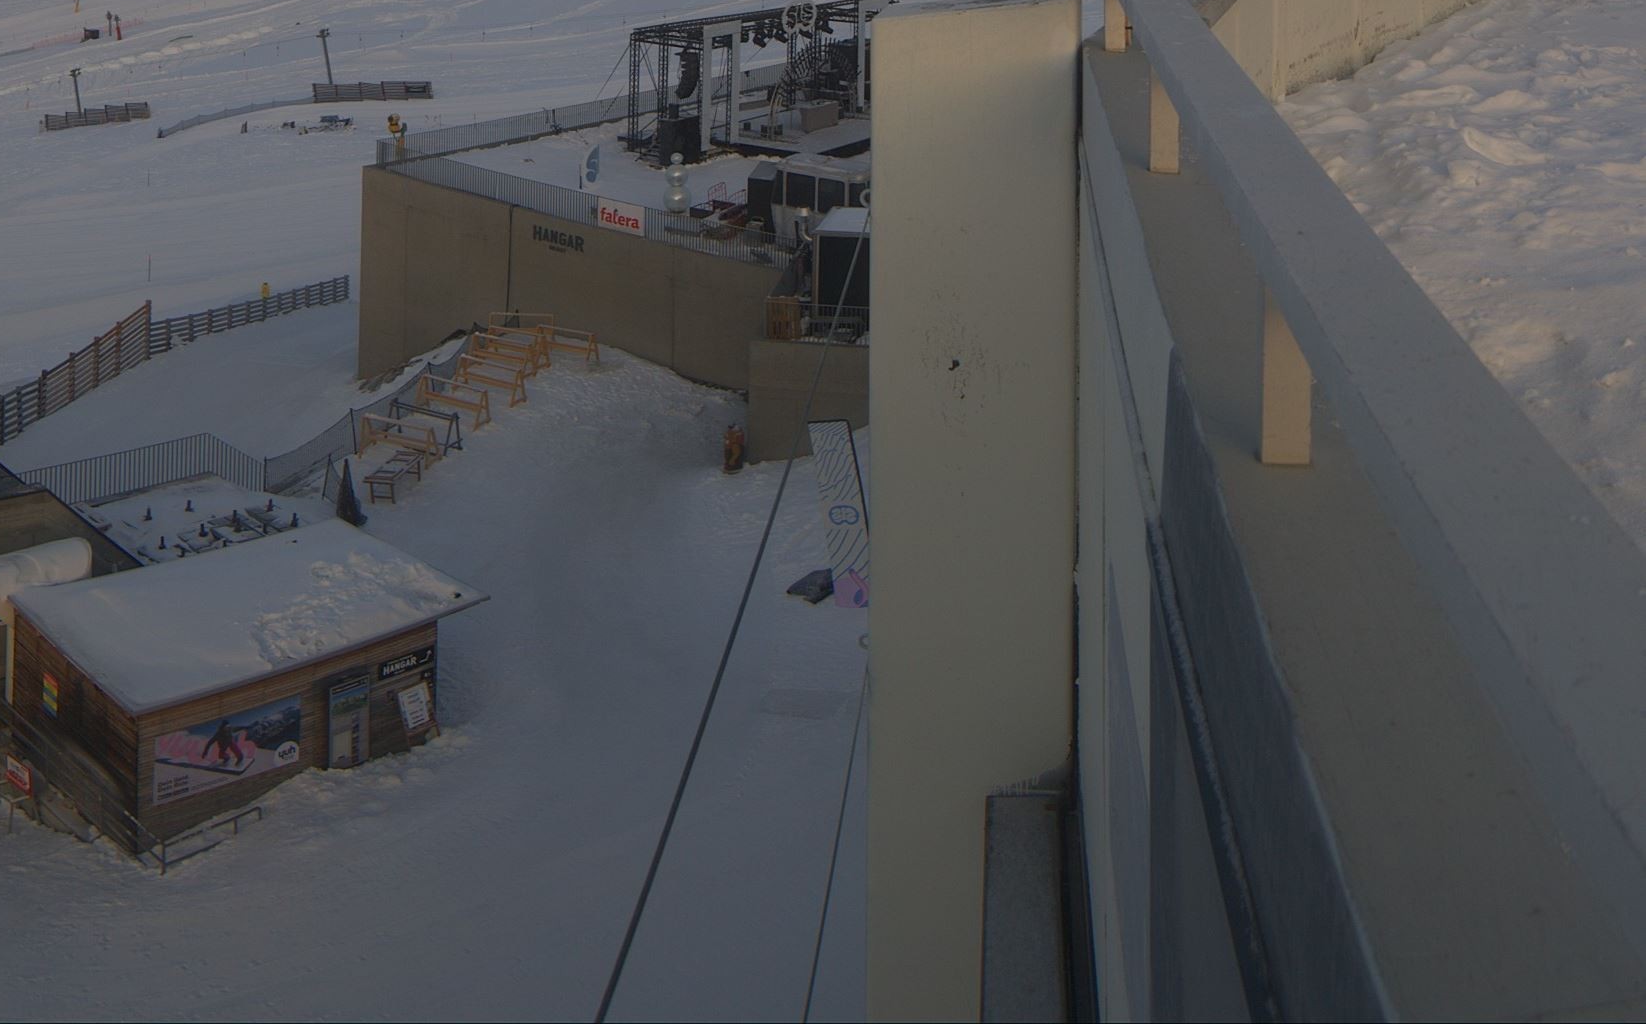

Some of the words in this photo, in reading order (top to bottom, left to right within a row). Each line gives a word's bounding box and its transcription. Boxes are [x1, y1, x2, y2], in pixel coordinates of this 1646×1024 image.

[600, 208, 640, 229] falera
[533, 225, 584, 252] HANGAR
[383, 657, 417, 676] HANGAR
